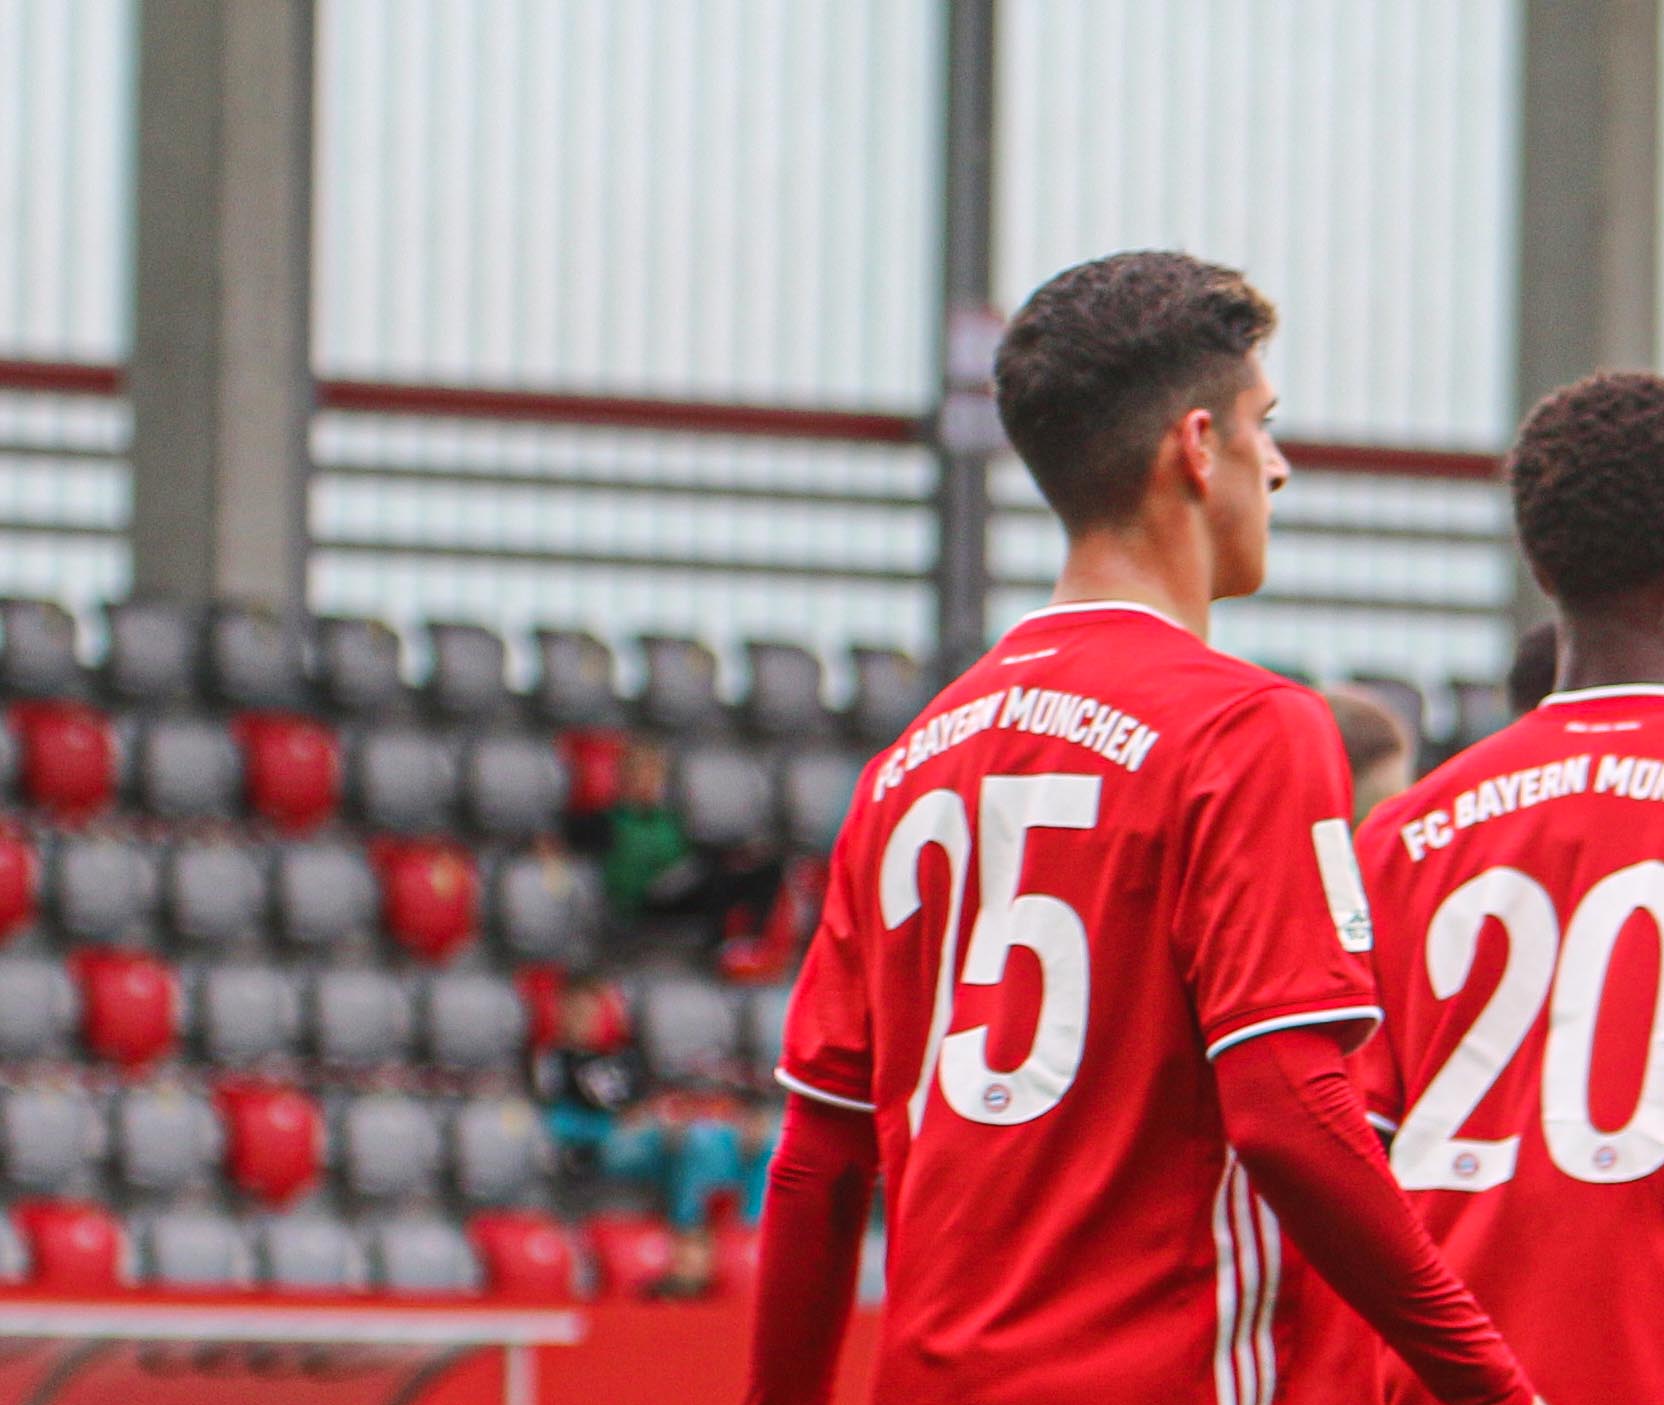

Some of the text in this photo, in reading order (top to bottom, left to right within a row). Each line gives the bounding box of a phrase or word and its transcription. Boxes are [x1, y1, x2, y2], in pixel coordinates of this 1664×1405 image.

[1400, 810, 1456, 863] FC
[1453, 753, 1593, 830] BAYERN
[879, 774, 1102, 1138] 25
